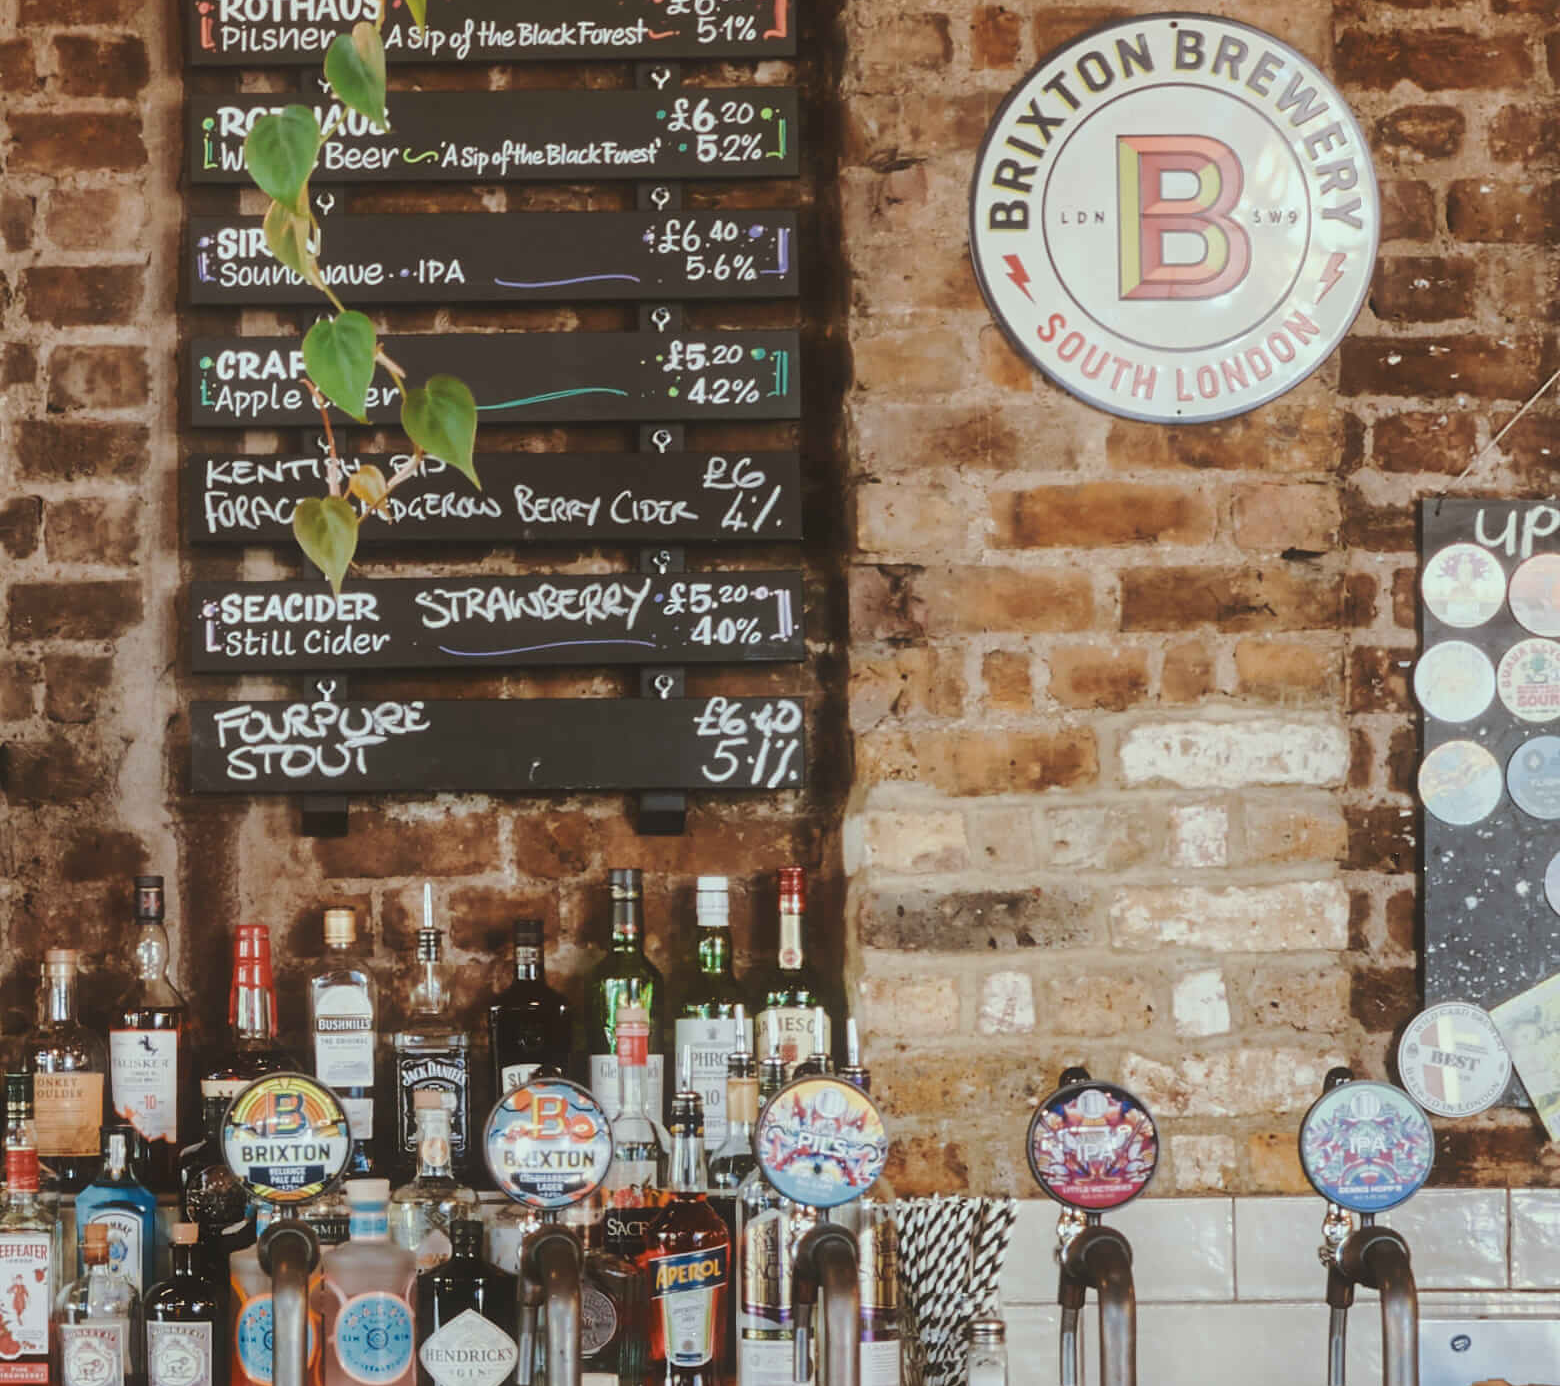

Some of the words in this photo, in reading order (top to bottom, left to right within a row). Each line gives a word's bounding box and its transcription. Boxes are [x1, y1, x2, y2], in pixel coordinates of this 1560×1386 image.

[221, 23, 336, 53] Pilsner
[449, 19, 475, 60] of
[478, 21, 516, 48] the
[517, 21, 576, 47] Black
[578, 17, 649, 47] Forest
[987, 32, 1156, 232] BRIXTON
[1173, 29, 1365, 231] BREWERY
[323, 142, 400, 171] Beer
[1060, 209, 1106, 225] LDN
[1115, 133, 1252, 302] B
[417, 258, 466, 285] IPA
[1036, 312, 1158, 402] SOUTH
[1175, 309, 1321, 403] LONDON
[214, 384, 303, 413] Apple
[701, 456, 767, 491] £6
[514, 484, 601, 526] BERRY
[610, 489, 699, 525] CIDER
[1473, 506, 1560, 557] UP
[220, 592, 380, 624] SEACIDER
[414, 577, 652, 631] STRAWBERRY
[225, 628, 297, 657] Still
[304, 627, 391, 656] Cider
[226, 732, 388, 780] STOUT
[1430, 1050, 1482, 1073] BEST
[241, 1143, 331, 1163] BRIXTON
[655, 1258, 722, 1290] APEROL
